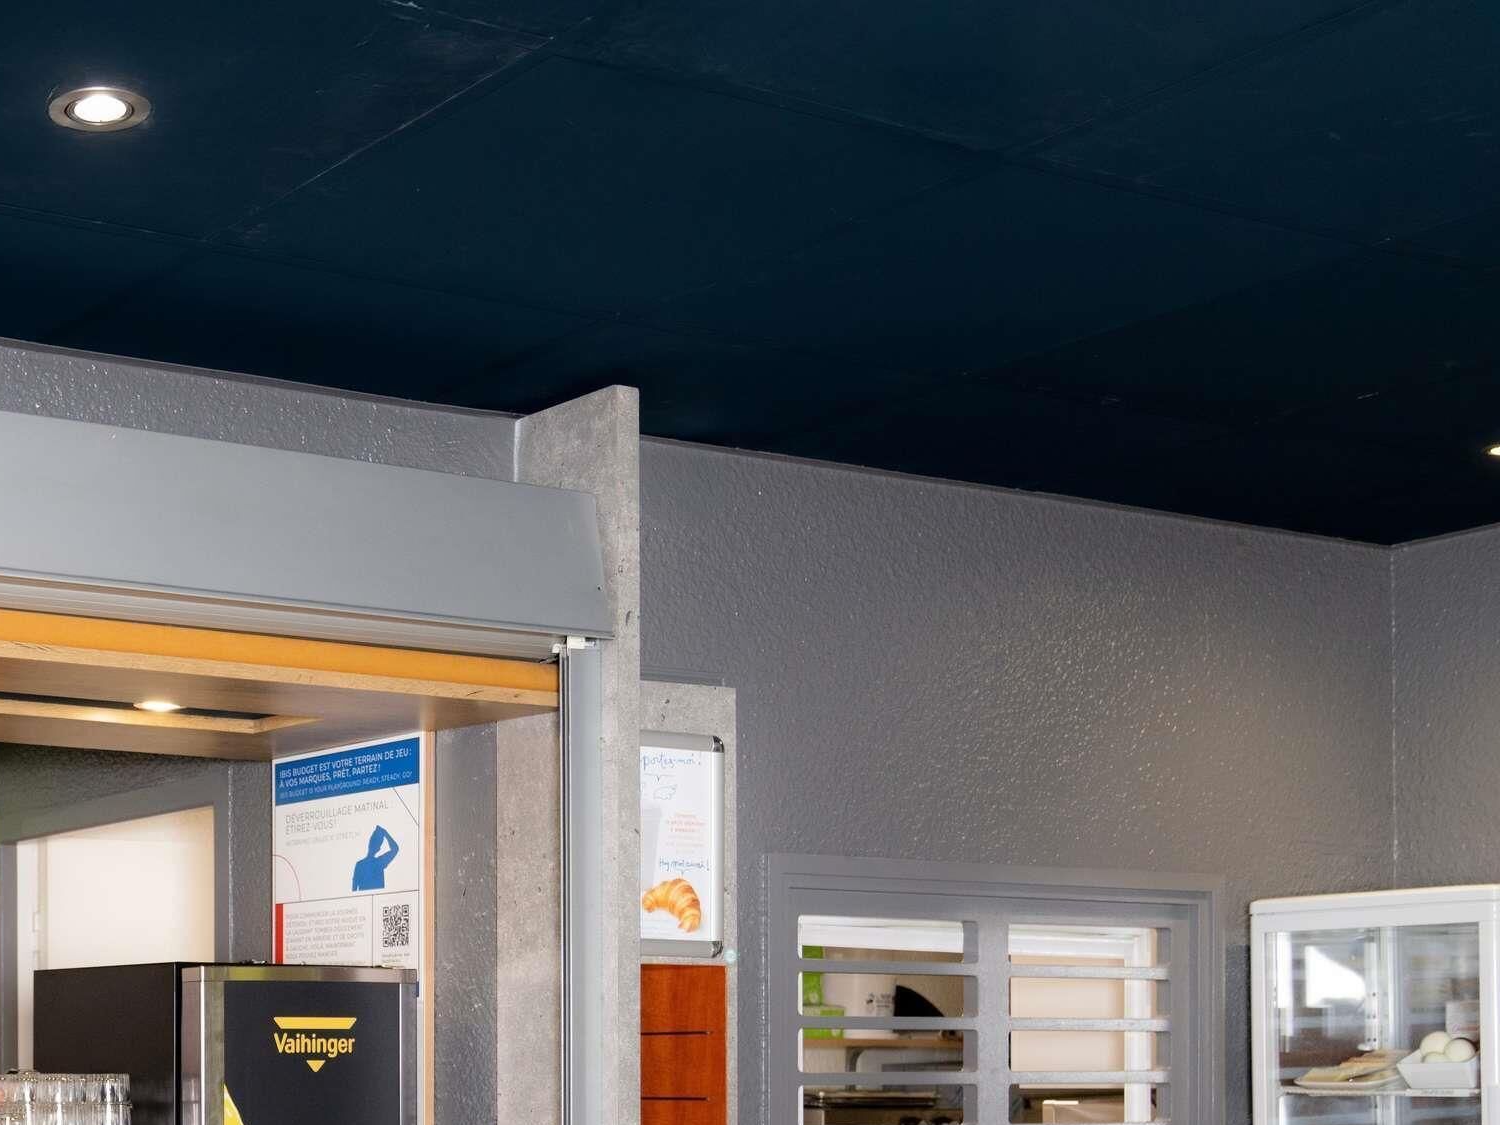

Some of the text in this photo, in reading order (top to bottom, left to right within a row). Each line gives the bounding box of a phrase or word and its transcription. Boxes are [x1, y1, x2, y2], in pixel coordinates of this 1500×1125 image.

[280, 769, 291, 779] IBIS
[292, 765, 318, 777] BUDGET
[319, 763, 330, 772] EST
[332, 759, 353, 769] VOTRE
[354, 754, 383, 766] TERRAIN
[384, 751, 394, 760] DE
[285, 778, 298, 787] VOS
[273, 1032, 356, 1058] Vaihinger
